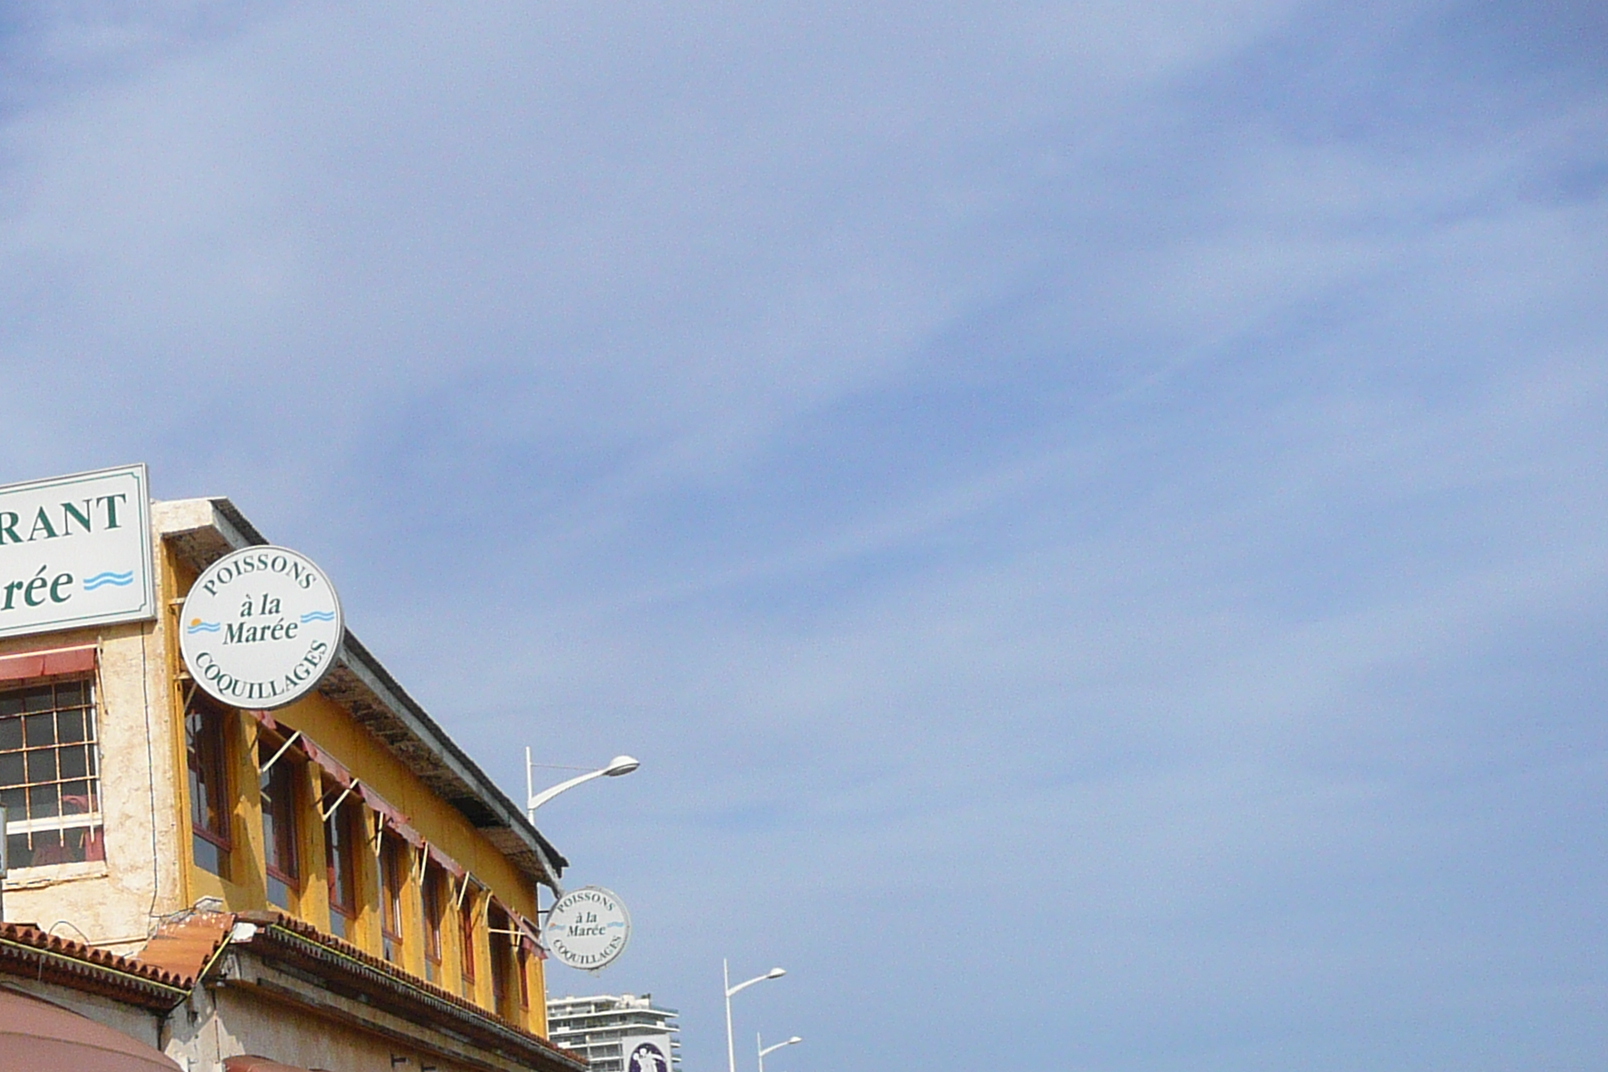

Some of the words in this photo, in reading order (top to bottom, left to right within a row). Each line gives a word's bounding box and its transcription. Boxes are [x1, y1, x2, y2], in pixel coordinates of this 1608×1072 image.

[202, 553, 317, 597] POISSONS
[240, 594, 254, 618] à
[259, 593, 282, 616] la
[222, 617, 299, 645] Marée
[195, 639, 328, 699] COQUILLAGES
[556, 892, 616, 913] POISSONS
[567, 923, 607, 938] Marée
[586, 911, 598, 924] la
[553, 935, 623, 965] COQUILLAGES
